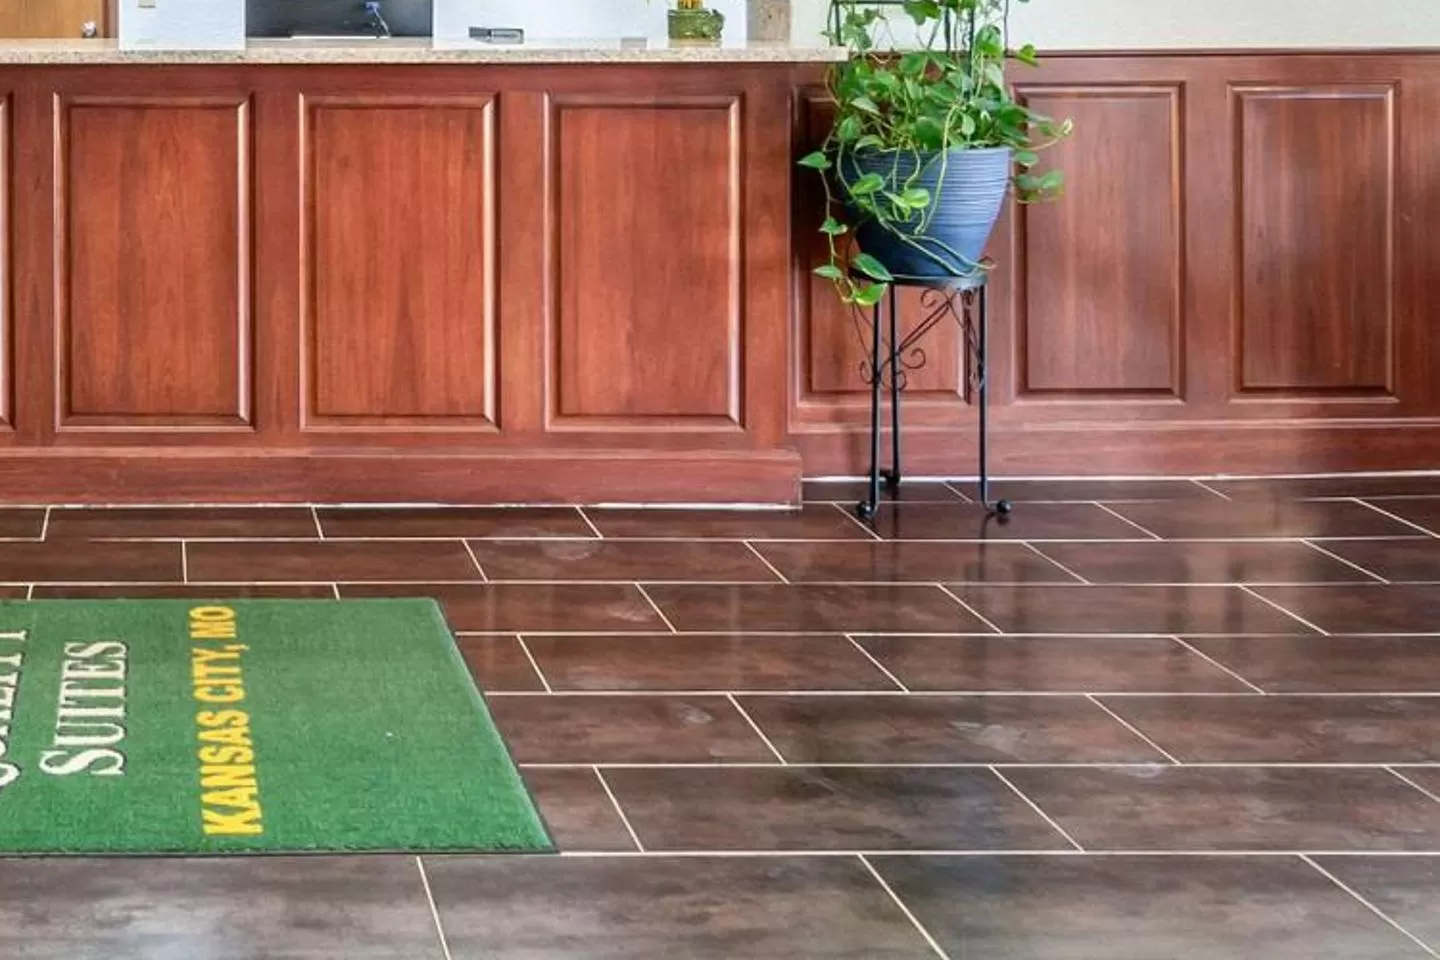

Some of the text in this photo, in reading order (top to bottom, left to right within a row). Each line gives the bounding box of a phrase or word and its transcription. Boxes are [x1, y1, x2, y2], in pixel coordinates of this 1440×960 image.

[38, 640, 129, 776] SUITES
[188, 605, 264, 836] KANSAS CITY, MO
